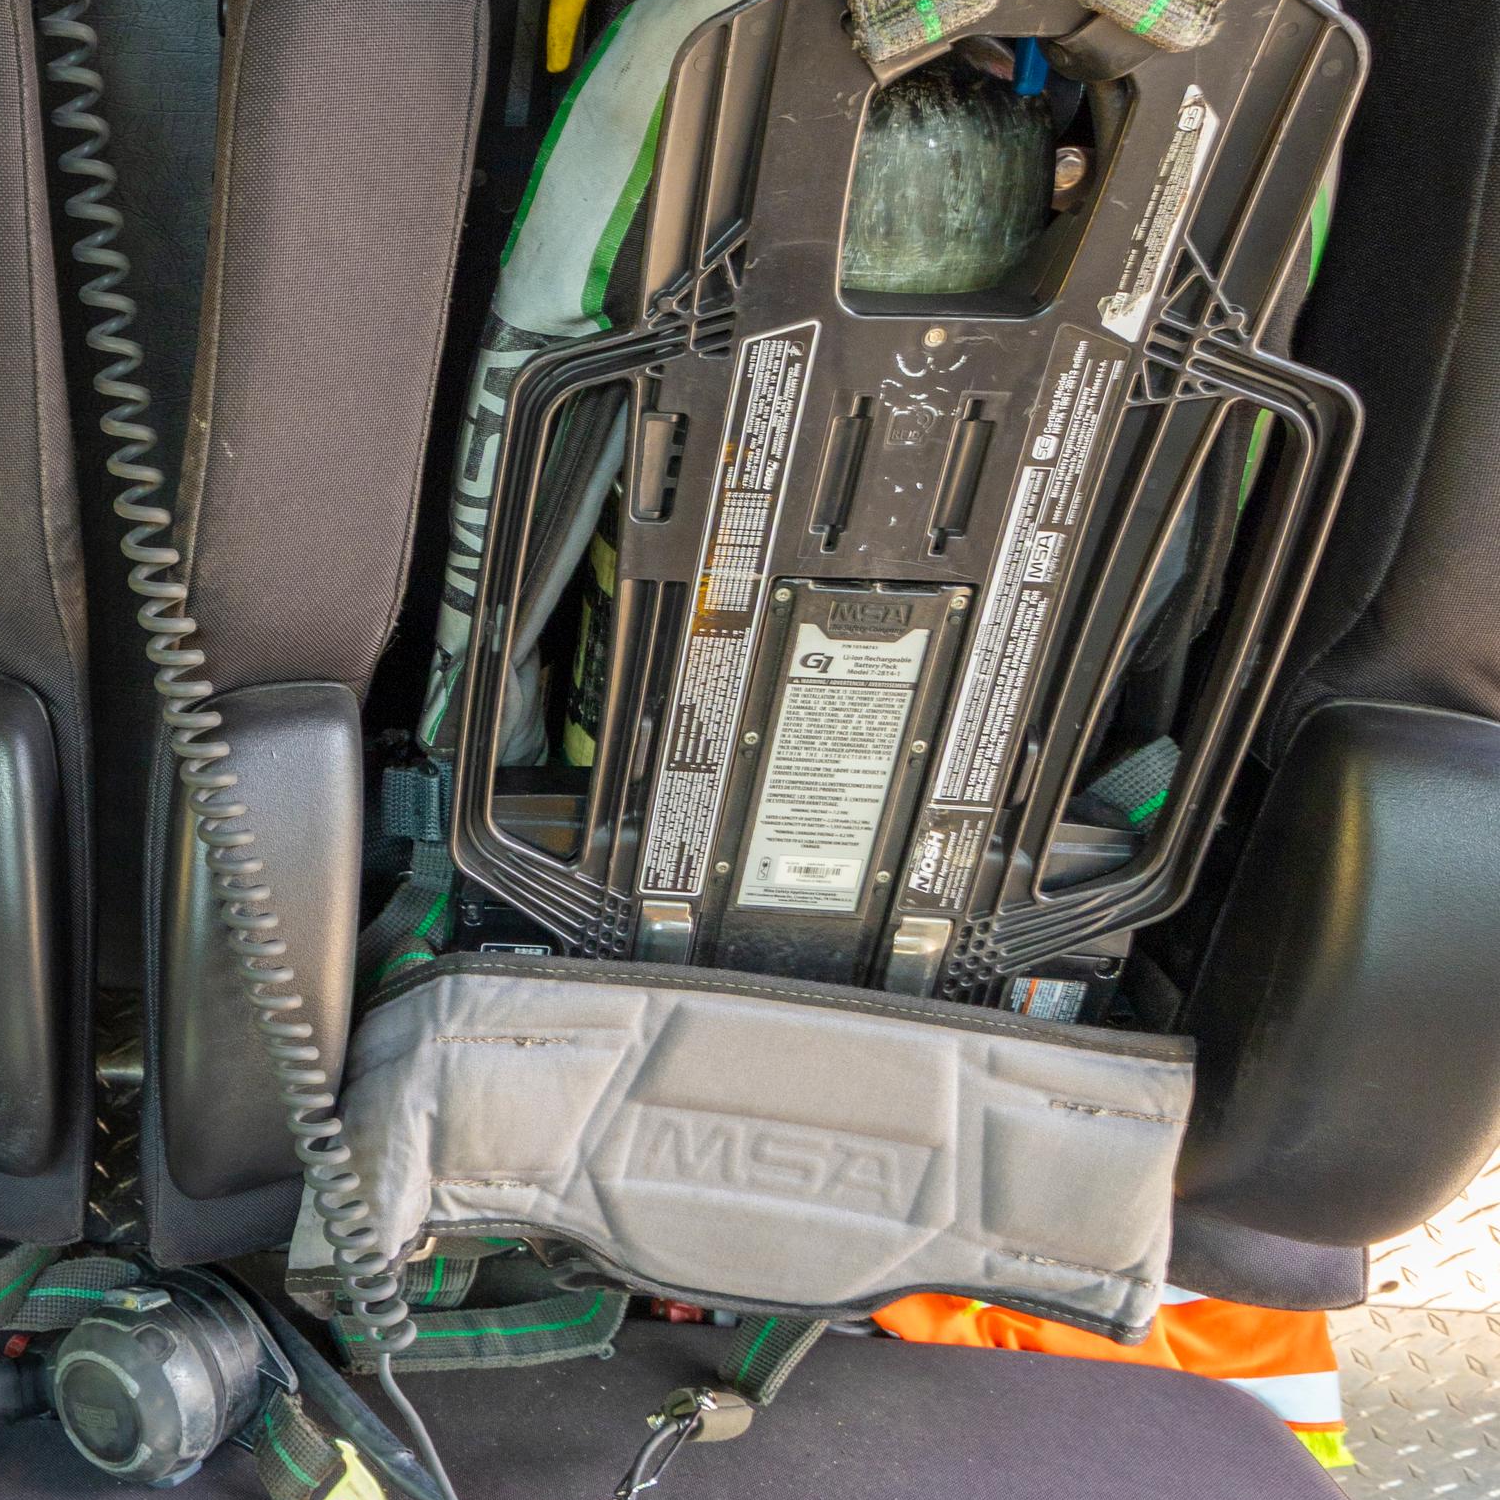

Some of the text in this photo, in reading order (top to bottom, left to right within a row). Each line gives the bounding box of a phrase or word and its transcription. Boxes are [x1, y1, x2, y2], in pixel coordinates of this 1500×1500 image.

[1028, 535, 1053, 581] MSA
[799, 652, 835, 674] G1
[915, 830, 946, 893] NIOSH
[644, 1117, 900, 1211] MSA
